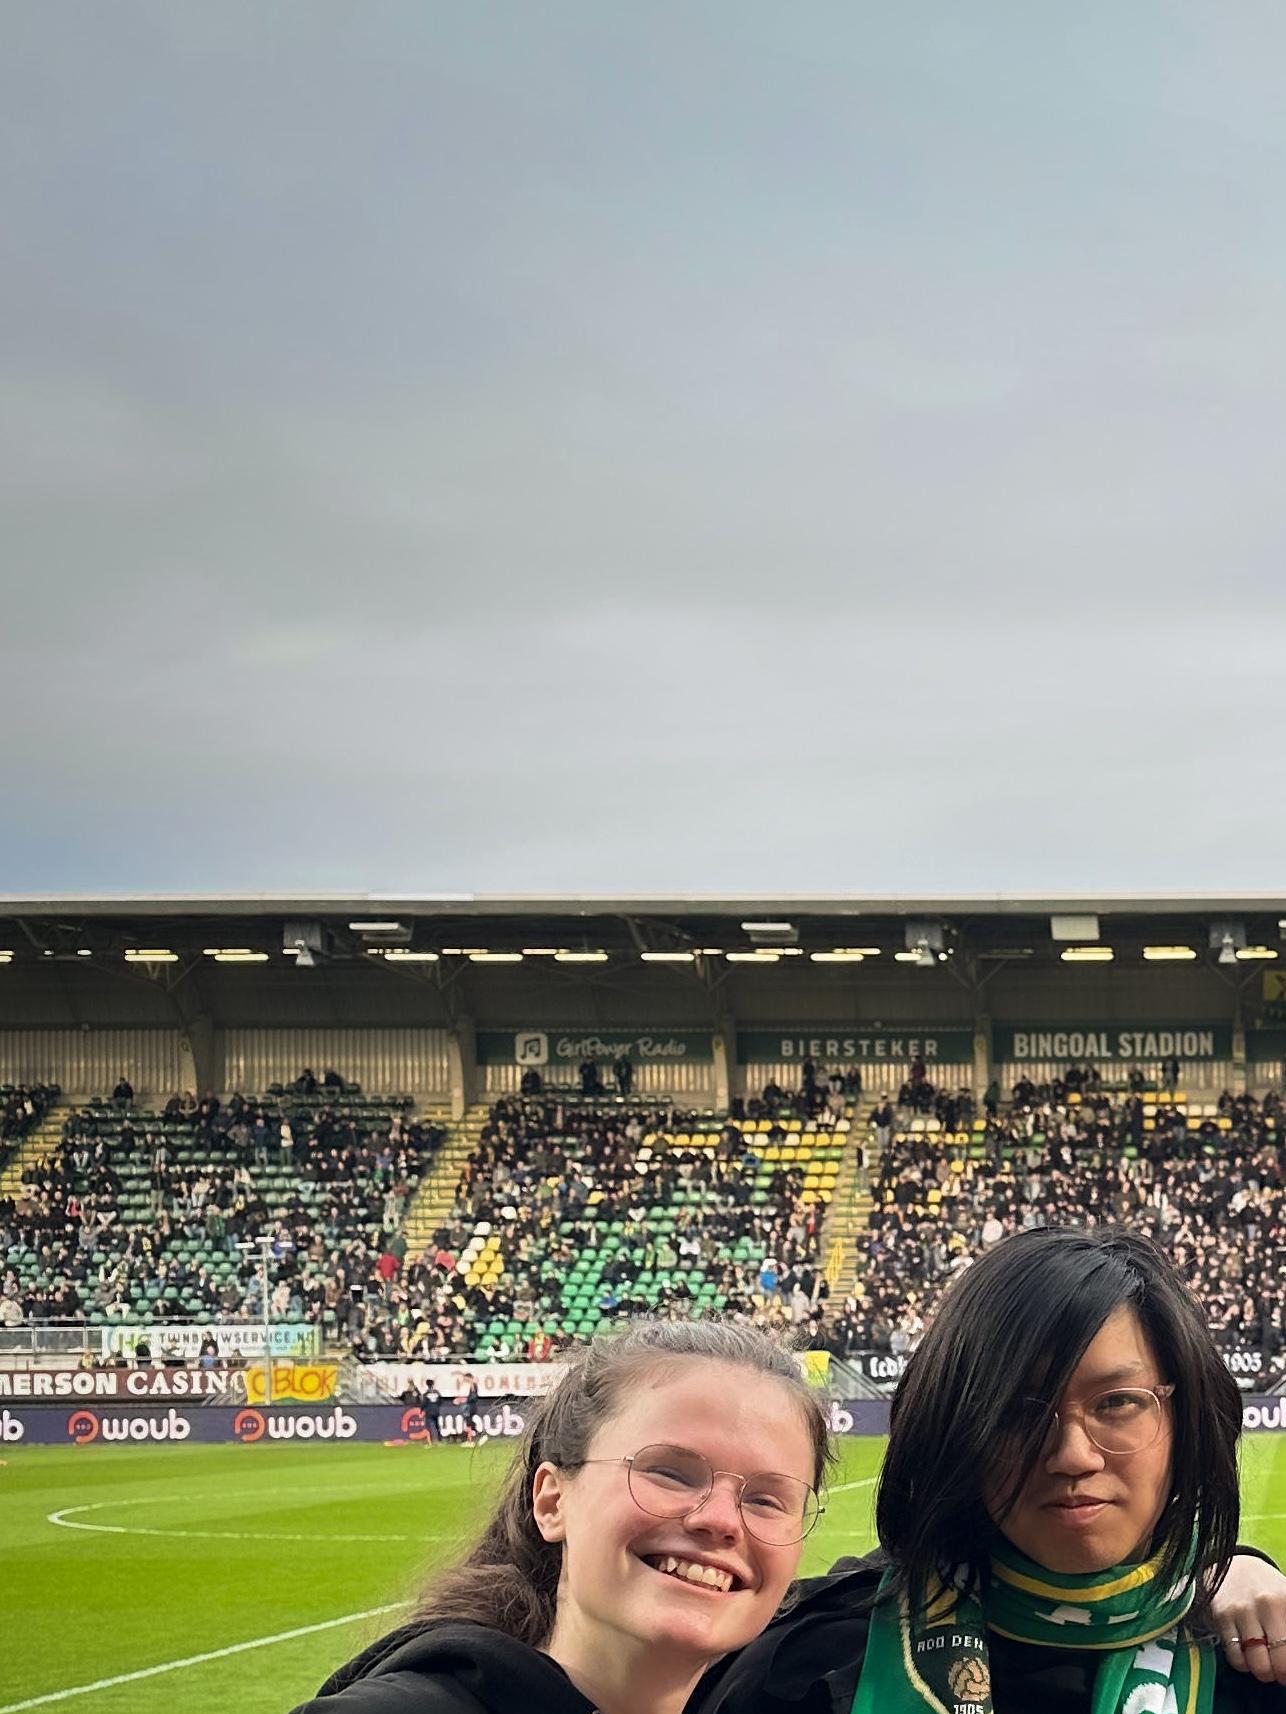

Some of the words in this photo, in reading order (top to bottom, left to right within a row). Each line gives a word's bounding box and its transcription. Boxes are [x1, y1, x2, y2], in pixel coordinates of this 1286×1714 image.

[638, 1037, 686, 1057] Radio
[781, 1039, 938, 1058] BIERSTEKER
[1013, 1032, 1112, 1058] BINGOAL
[1118, 1031, 1214, 1057] STADION
[102, 1408, 191, 1440] woub
[268, 1407, 357, 1439] woub
